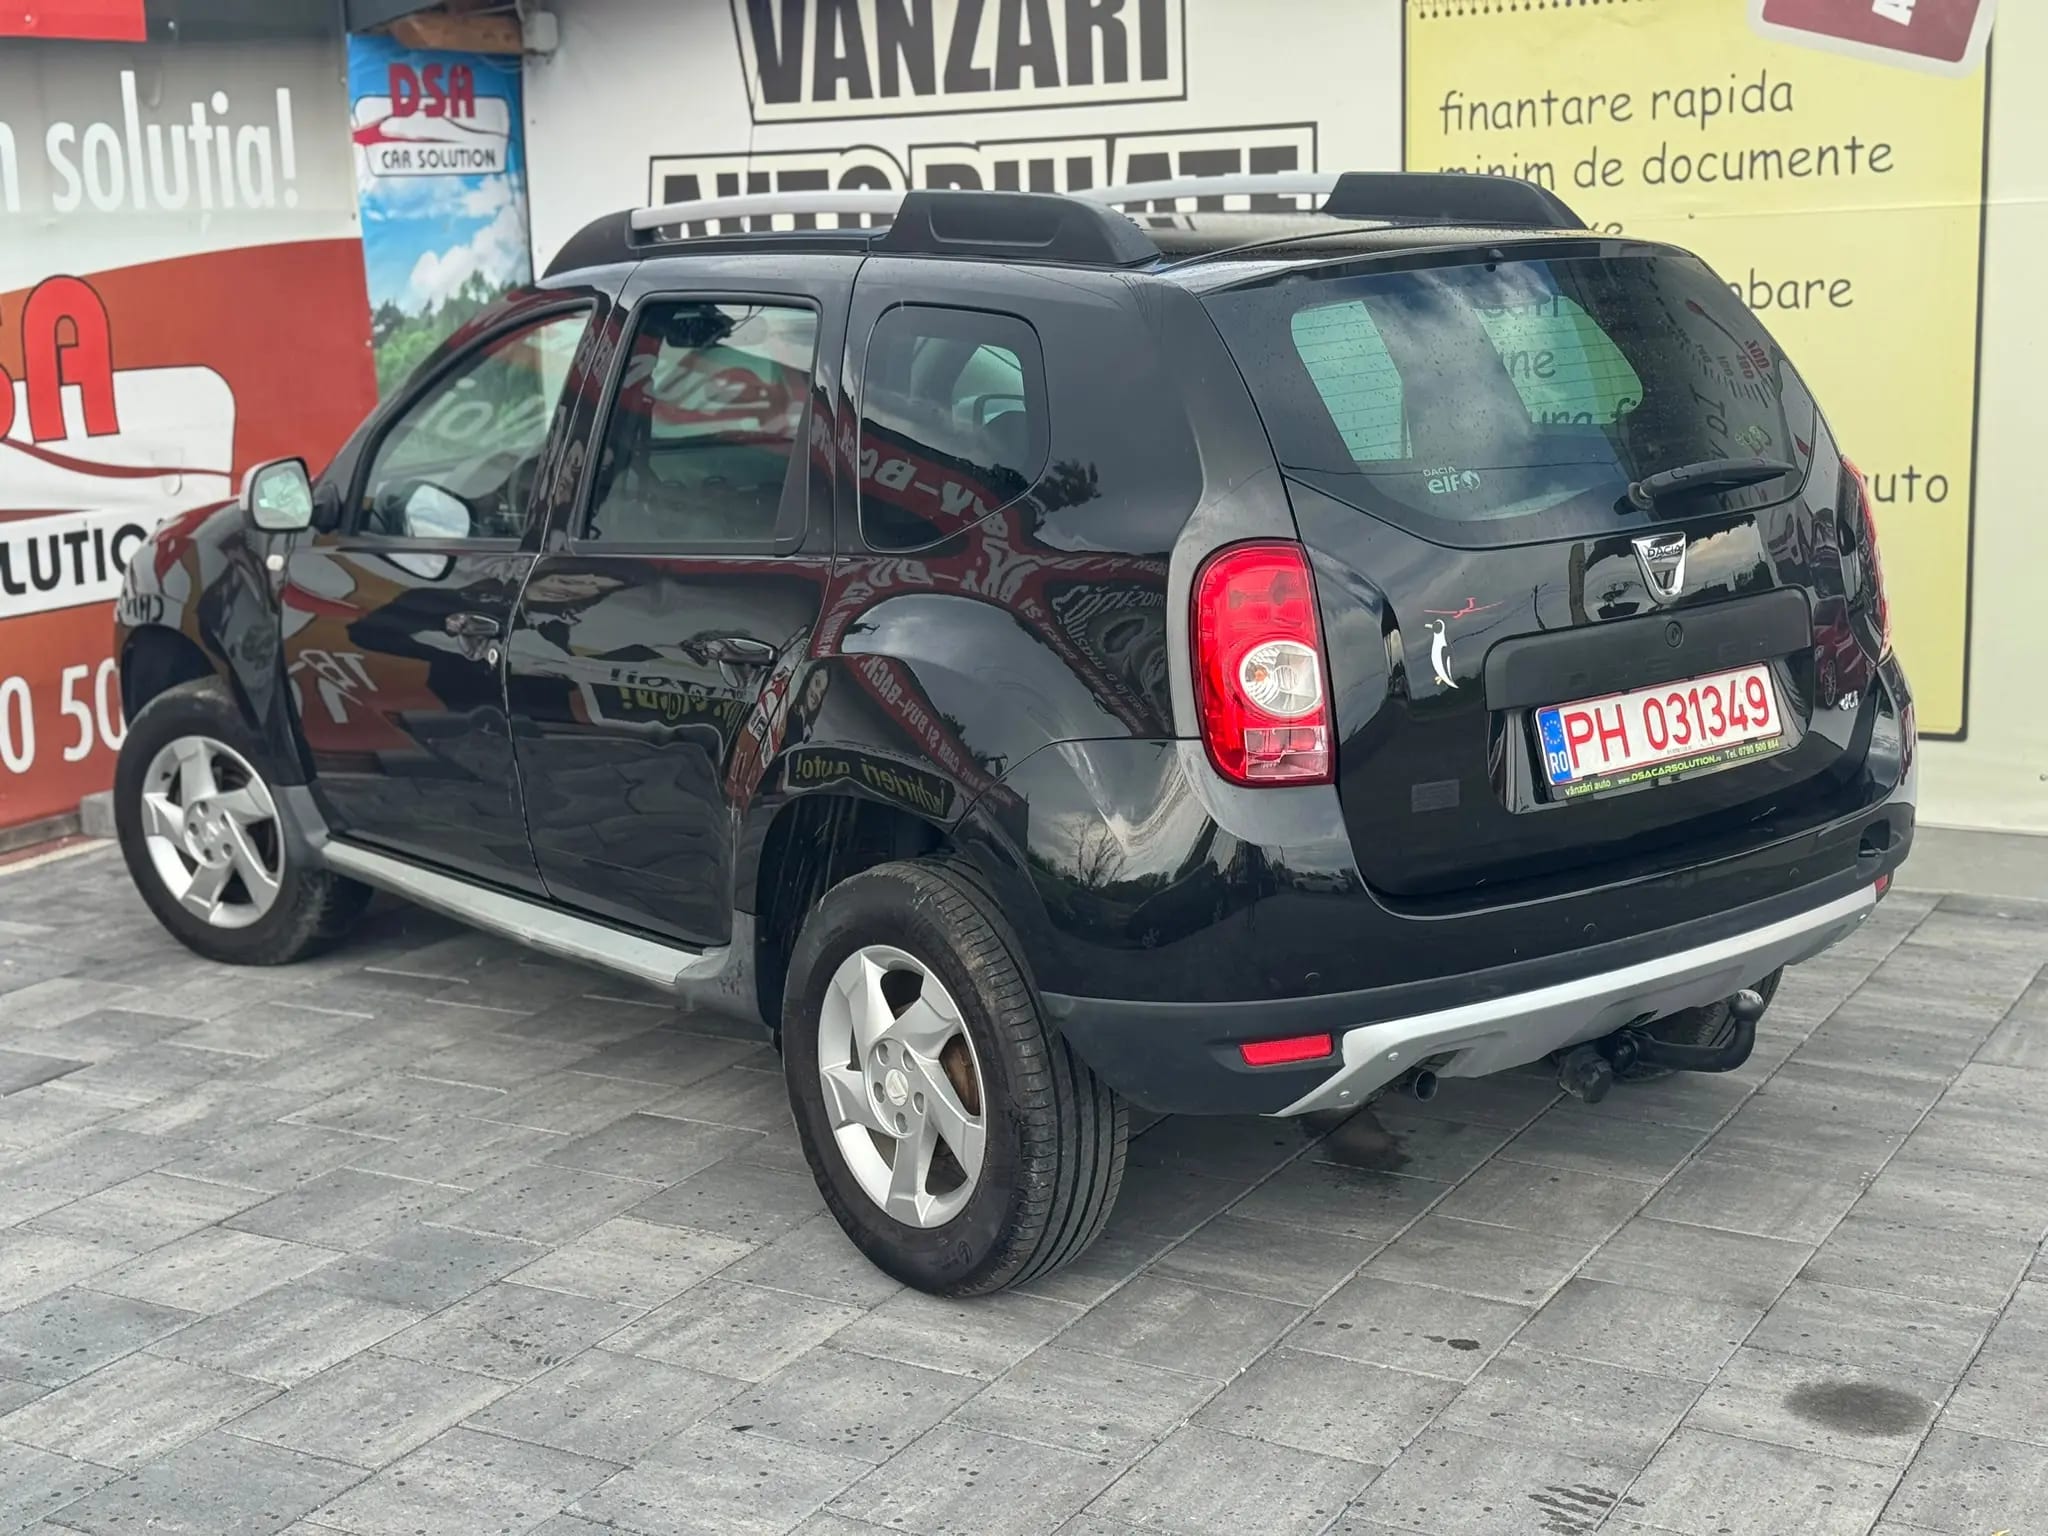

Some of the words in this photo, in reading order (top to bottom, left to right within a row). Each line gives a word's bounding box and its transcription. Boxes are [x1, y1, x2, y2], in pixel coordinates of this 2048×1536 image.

[388, 62, 476, 118] DSA
[1439, 89, 1633, 135] finantare
[1651, 68, 1794, 131] rapida
[381, 149, 411, 169] CAR
[418, 148, 497, 169] SOLUTION
[1574, 145, 1625, 188] de
[1642, 136, 1895, 184] documente
[0, 275, 120, 443] A
[1423, 466, 1456, 477] DACIA
[1428, 474, 1460, 494] elf
[1863, 464, 1949, 504] uto
[1647, 544, 1682, 558] DACIA
[1563, 703, 1631, 769] PH
[1642, 675, 1770, 751] 031349
[1550, 751, 1569, 775] RO
[1594, 779, 1612, 791] auto
